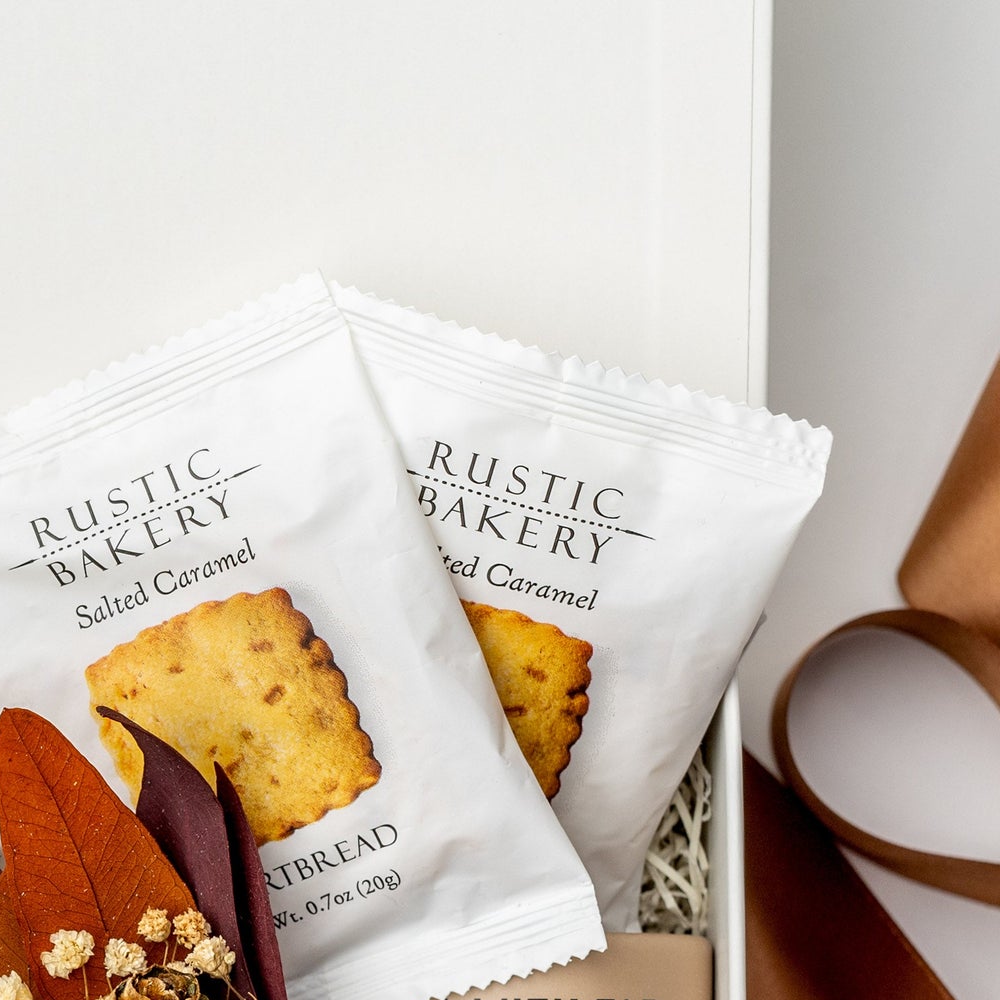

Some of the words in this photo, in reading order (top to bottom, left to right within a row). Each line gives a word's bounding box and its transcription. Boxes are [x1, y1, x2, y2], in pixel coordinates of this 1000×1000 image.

[29, 448, 221, 548] RUSTIC
[427, 440, 624, 520] RUSTIC
[46, 490, 231, 587] BAKERY
[417, 485, 612, 564] BAKERY
[75, 581, 150, 629] Salted
[153, 538, 256, 595] Caramel
[437, 545, 479, 579] ted
[486, 563, 599, 610] Caramel
[306, 894, 354, 915] 0.7oz
[356, 868, 402, 899] (20g)
